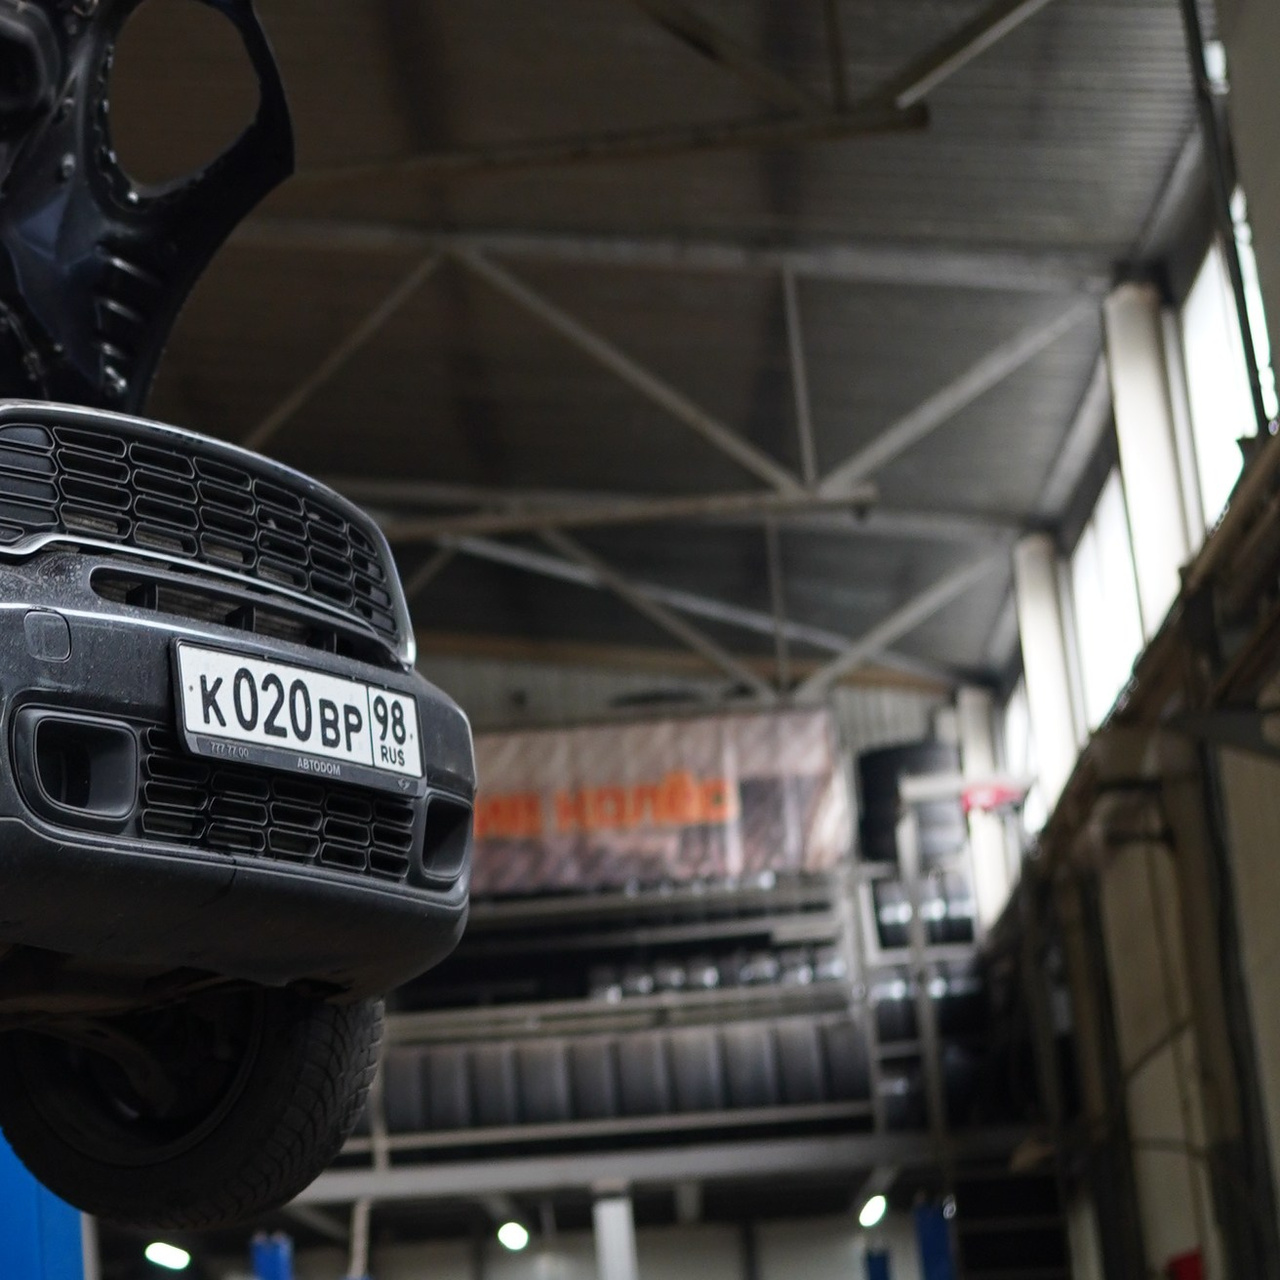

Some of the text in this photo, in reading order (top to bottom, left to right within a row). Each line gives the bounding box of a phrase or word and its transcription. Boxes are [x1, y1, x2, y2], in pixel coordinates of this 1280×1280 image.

[199, 667, 363, 752] К020ВР
[373, 695, 406, 746] 98
[381, 744, 405, 767] RUS
